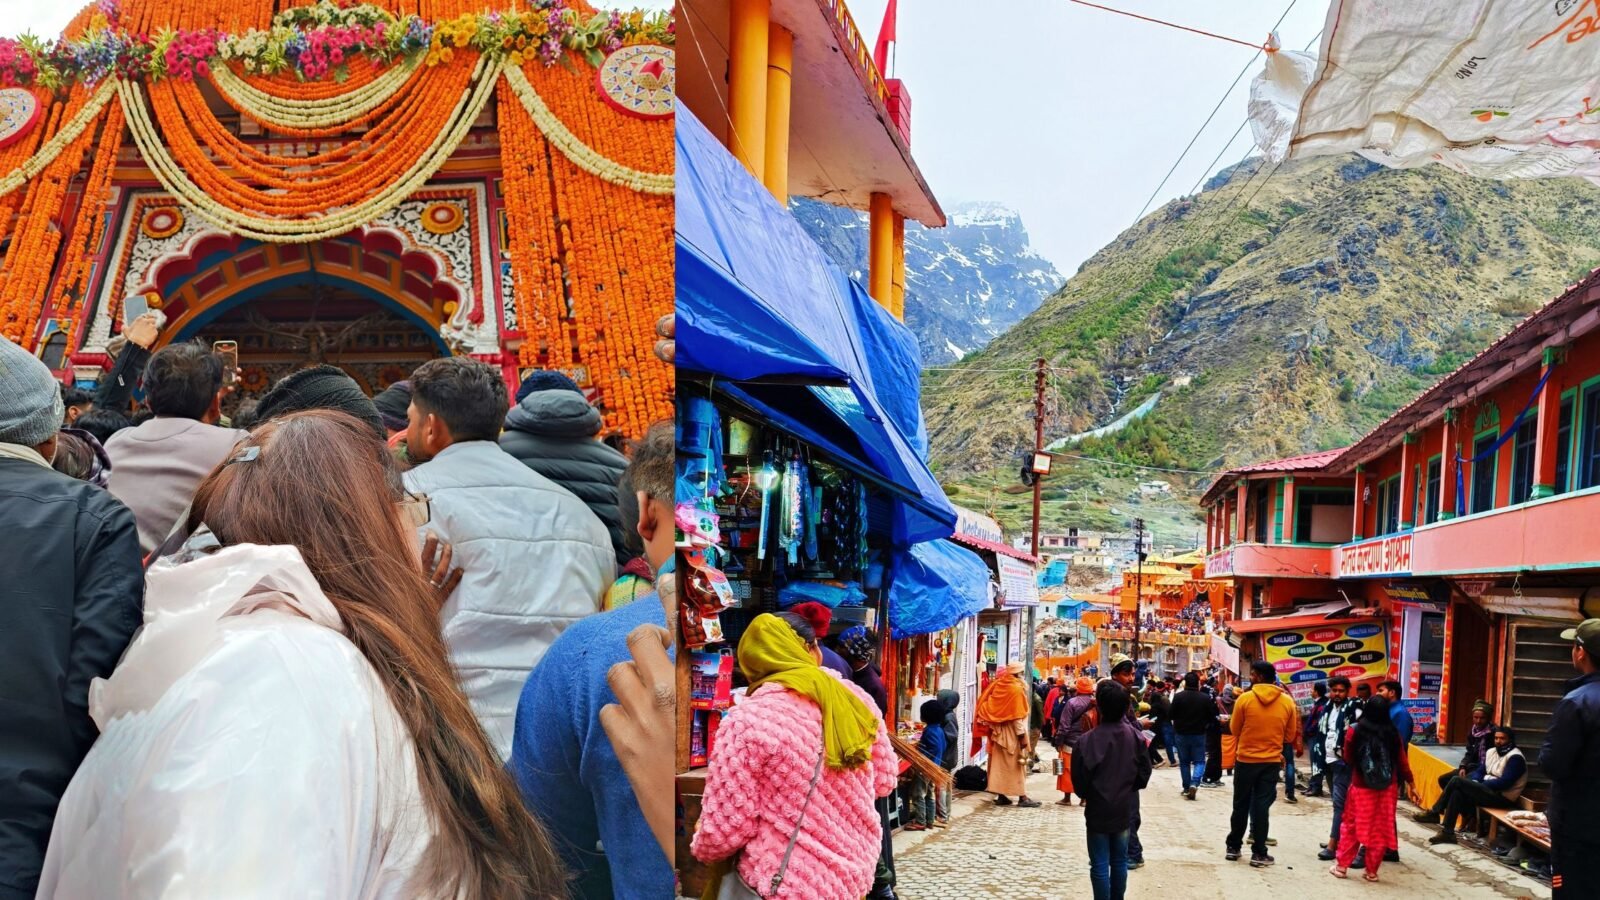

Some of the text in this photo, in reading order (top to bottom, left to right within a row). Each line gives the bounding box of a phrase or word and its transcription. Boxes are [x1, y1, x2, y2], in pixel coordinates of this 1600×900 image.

[1357, 540, 1383, 573] कल्याण
[1383, 534, 1412, 572] आश्रम
[1314, 631, 1335, 639] SAFFRON
[1273, 635, 1297, 644] SHILAJEET
[1306, 645, 1322, 653] SQUASH
[1326, 657, 1341, 665] CANDY
[1360, 653, 1373, 661] TULSI
